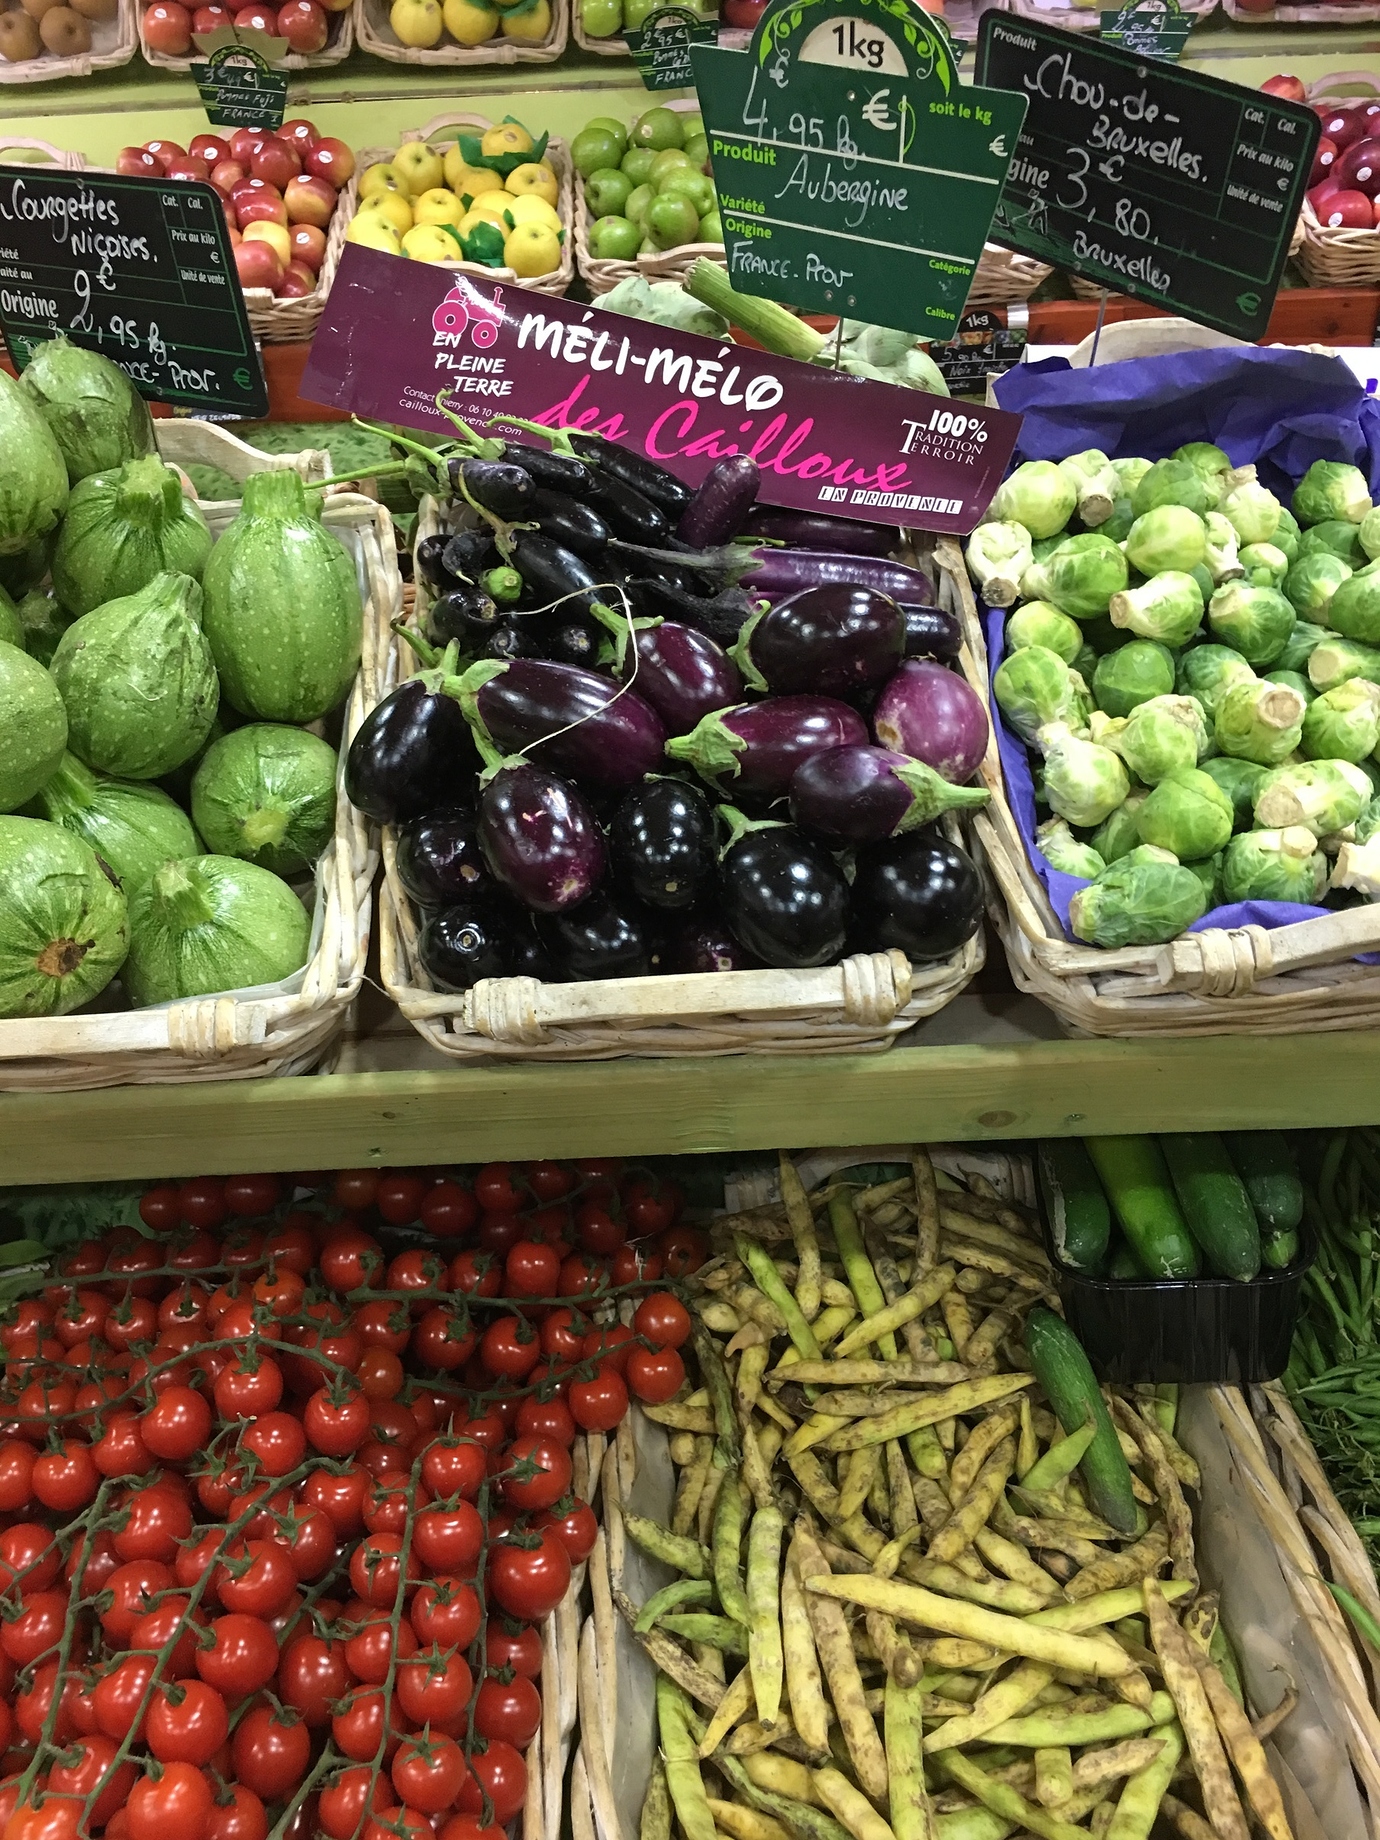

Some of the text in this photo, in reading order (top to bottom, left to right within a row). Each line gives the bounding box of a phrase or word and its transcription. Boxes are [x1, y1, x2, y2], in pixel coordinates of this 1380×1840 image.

[832, 20, 885, 68] 1kg
[993, 26, 1037, 52] Produit
[231, 55, 248, 67] 1kg
[222, 108, 266, 119] FRANCE
[929, 101, 993, 126] soit le kg
[1244, 108, 1297, 135] Cat. Cal.
[712, 139, 777, 166] Produit
[1236, 143, 1295, 173] Prix au kilo
[162, 194, 204, 210] Cat. Cal.
[774, 153, 909, 228] Aubergine
[1226, 184, 1284, 213] Unité de vente
[720, 194, 766, 214] Variété
[171, 229, 216, 246] Prix au kilo
[725, 217, 773, 239] Origine
[20, 270, 34, 280] au
[181, 269, 226, 286] Unité de vente
[929, 259, 971, 276] Catégorie
[0, 288, 60, 320] Origine
[925, 306, 956, 321] Calibre
[966, 314, 990, 328] 1kg
[432, 330, 462, 349] EN
[434, 351, 507, 374] PLEINE
[517, 310, 784, 412] MÉLI-MÉLO
[453, 375, 514, 398] TERRE
[403, 385, 436, 403] Contact
[468, 404, 480, 414] 06
[481, 407, 493, 418] 10
[530, 373, 630, 442] des
[928, 409, 988, 443] 100%
[644, 399, 913, 493] Cailloux
[817, 485, 964, 515] EN PROVENCE
